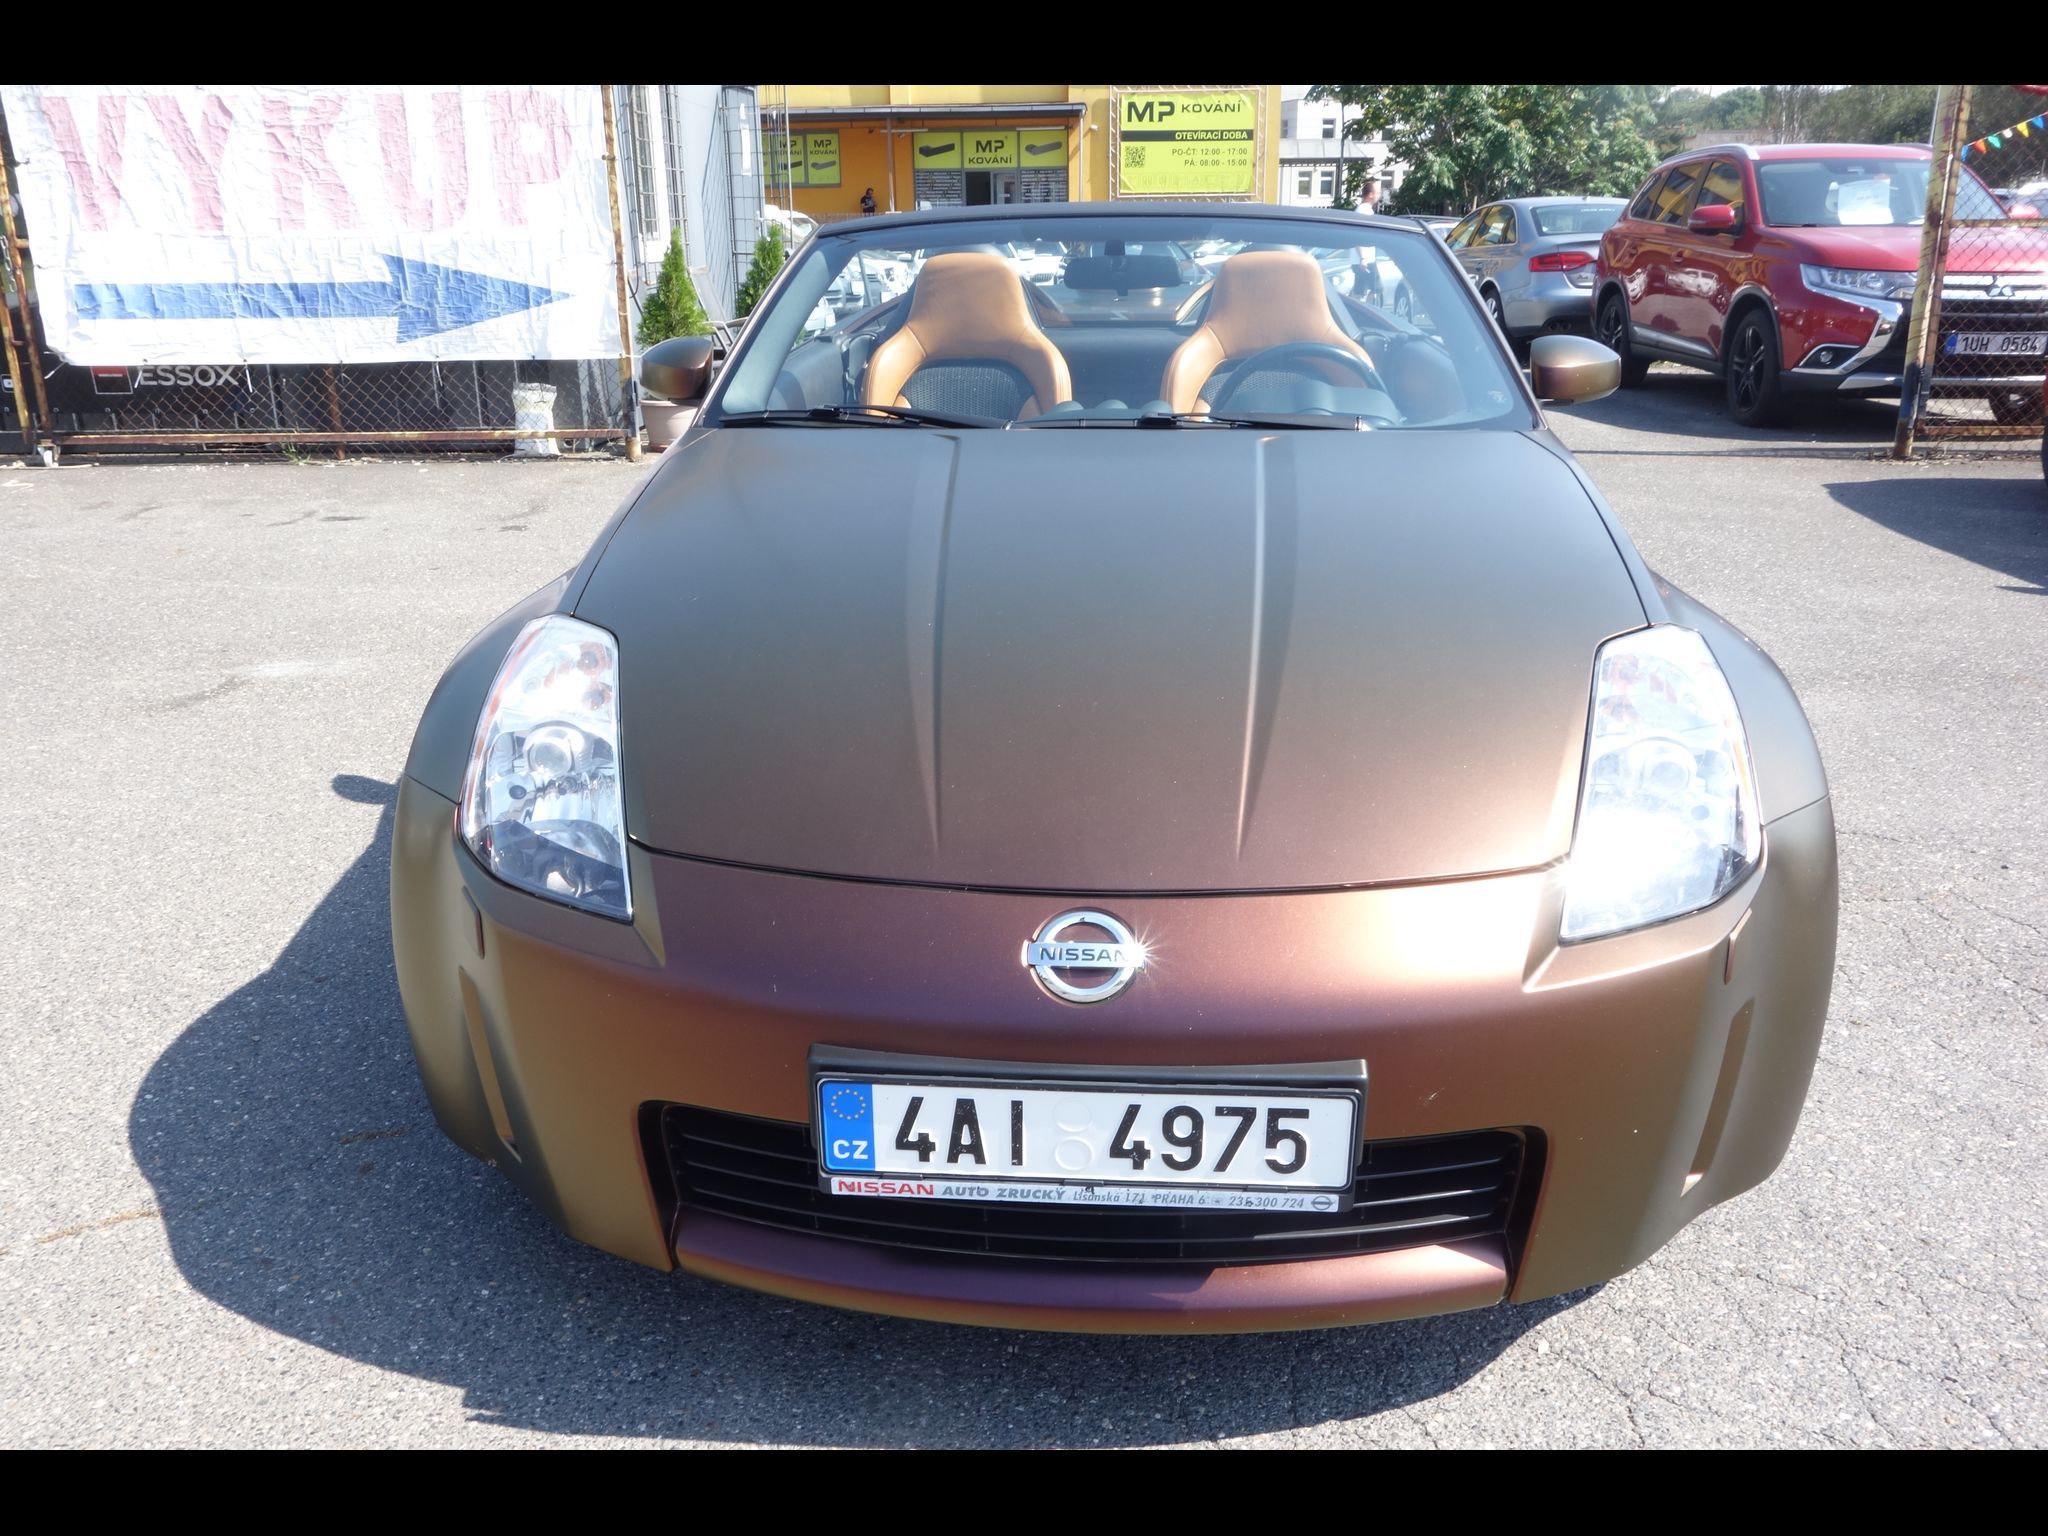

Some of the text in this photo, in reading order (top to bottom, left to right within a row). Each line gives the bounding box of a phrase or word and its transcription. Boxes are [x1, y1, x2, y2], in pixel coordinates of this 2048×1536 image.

[1127, 100, 1241, 122] MP KOVÁNÍ
[1175, 130, 1248, 140] OTEVÍRACÍ DOBA
[814, 139, 832, 148] MP
[975, 140, 1004, 153] MP
[1172, 147, 1197, 155] PO-ČT:
[968, 154, 1012, 164] KOVÁNÍ
[1184, 157, 1197, 166] PÁ:
[1963, 336, 2038, 351] 1UH 0584
[139, 365, 239, 386] ESSOX
[895, 1096, 1310, 1174] 4AI 4975
[833, 1139, 868, 1159] CZ
[838, 1180, 934, 1196] NISSAN
[942, 1185, 990, 1197] AUTO
[1154, 1194, 1194, 1206] PRAHA
[1255, 1197, 1278, 1208] 300
[1281, 1198, 1304, 1209] 724
